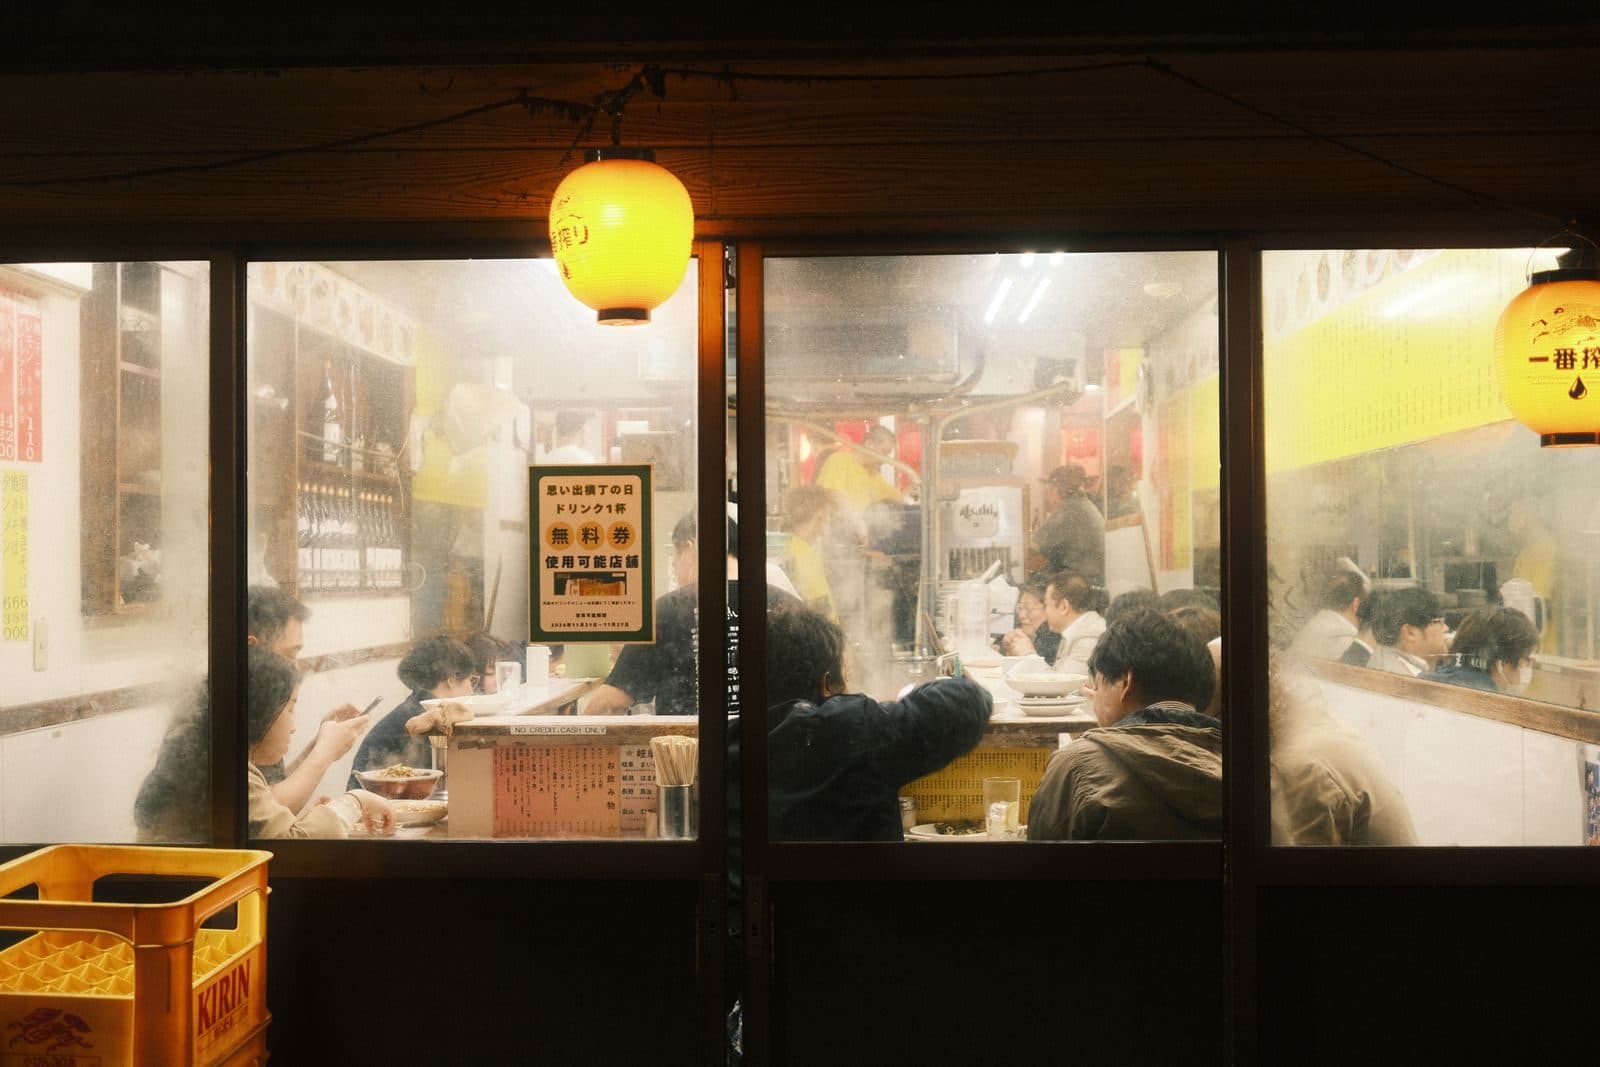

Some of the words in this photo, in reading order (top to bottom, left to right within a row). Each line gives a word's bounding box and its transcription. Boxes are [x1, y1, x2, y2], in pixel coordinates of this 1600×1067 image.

[547, 485, 633, 496] 思い出横丁の日
[557, 503, 626, 514] ドリンク1杯
[552, 527, 630, 544] 無料券
[545, 555, 639, 569] 使用可能店舗
[607, 762, 616, 810] お飲み物
[198, 958, 250, 1036] KIRIN
